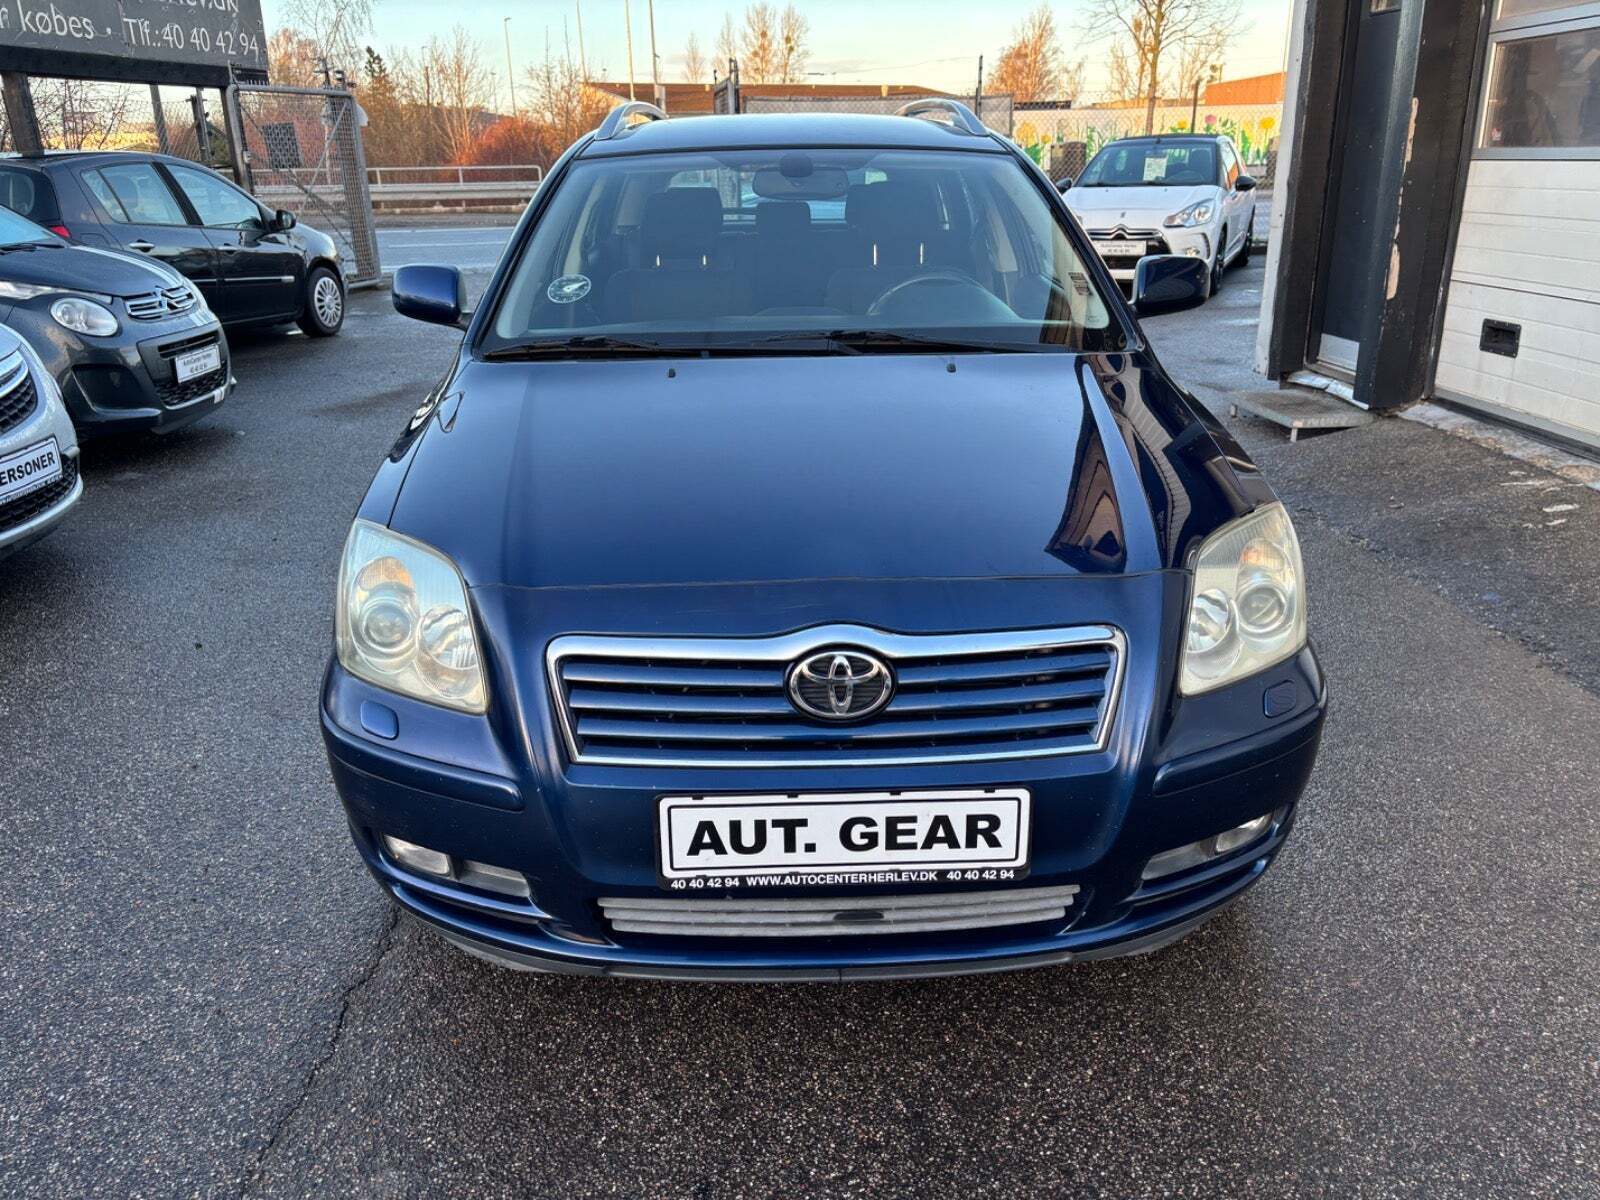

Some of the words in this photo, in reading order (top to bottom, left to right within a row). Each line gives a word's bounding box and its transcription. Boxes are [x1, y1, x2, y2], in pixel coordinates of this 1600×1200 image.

[16, 0, 95, 39] købes
[190, 27, 211, 52] 40
[216, 31, 237, 55] 42
[240, 32, 259, 61] 94
[686, 818, 817, 857] AUT.
[839, 813, 1003, 853] GEAR
[670, 879, 687, 890] 40
[688, 878, 704, 889] 40
[706, 877, 723, 888] 42
[724, 876, 740, 888] 94
[746, 870, 938, 887] WWW.AUTOCENTERHERLEV.DK
[946, 871, 962, 881] 40
[964, 870, 980, 880] 40
[981, 869, 997, 880] 42
[1000, 868, 1015, 880] 94
